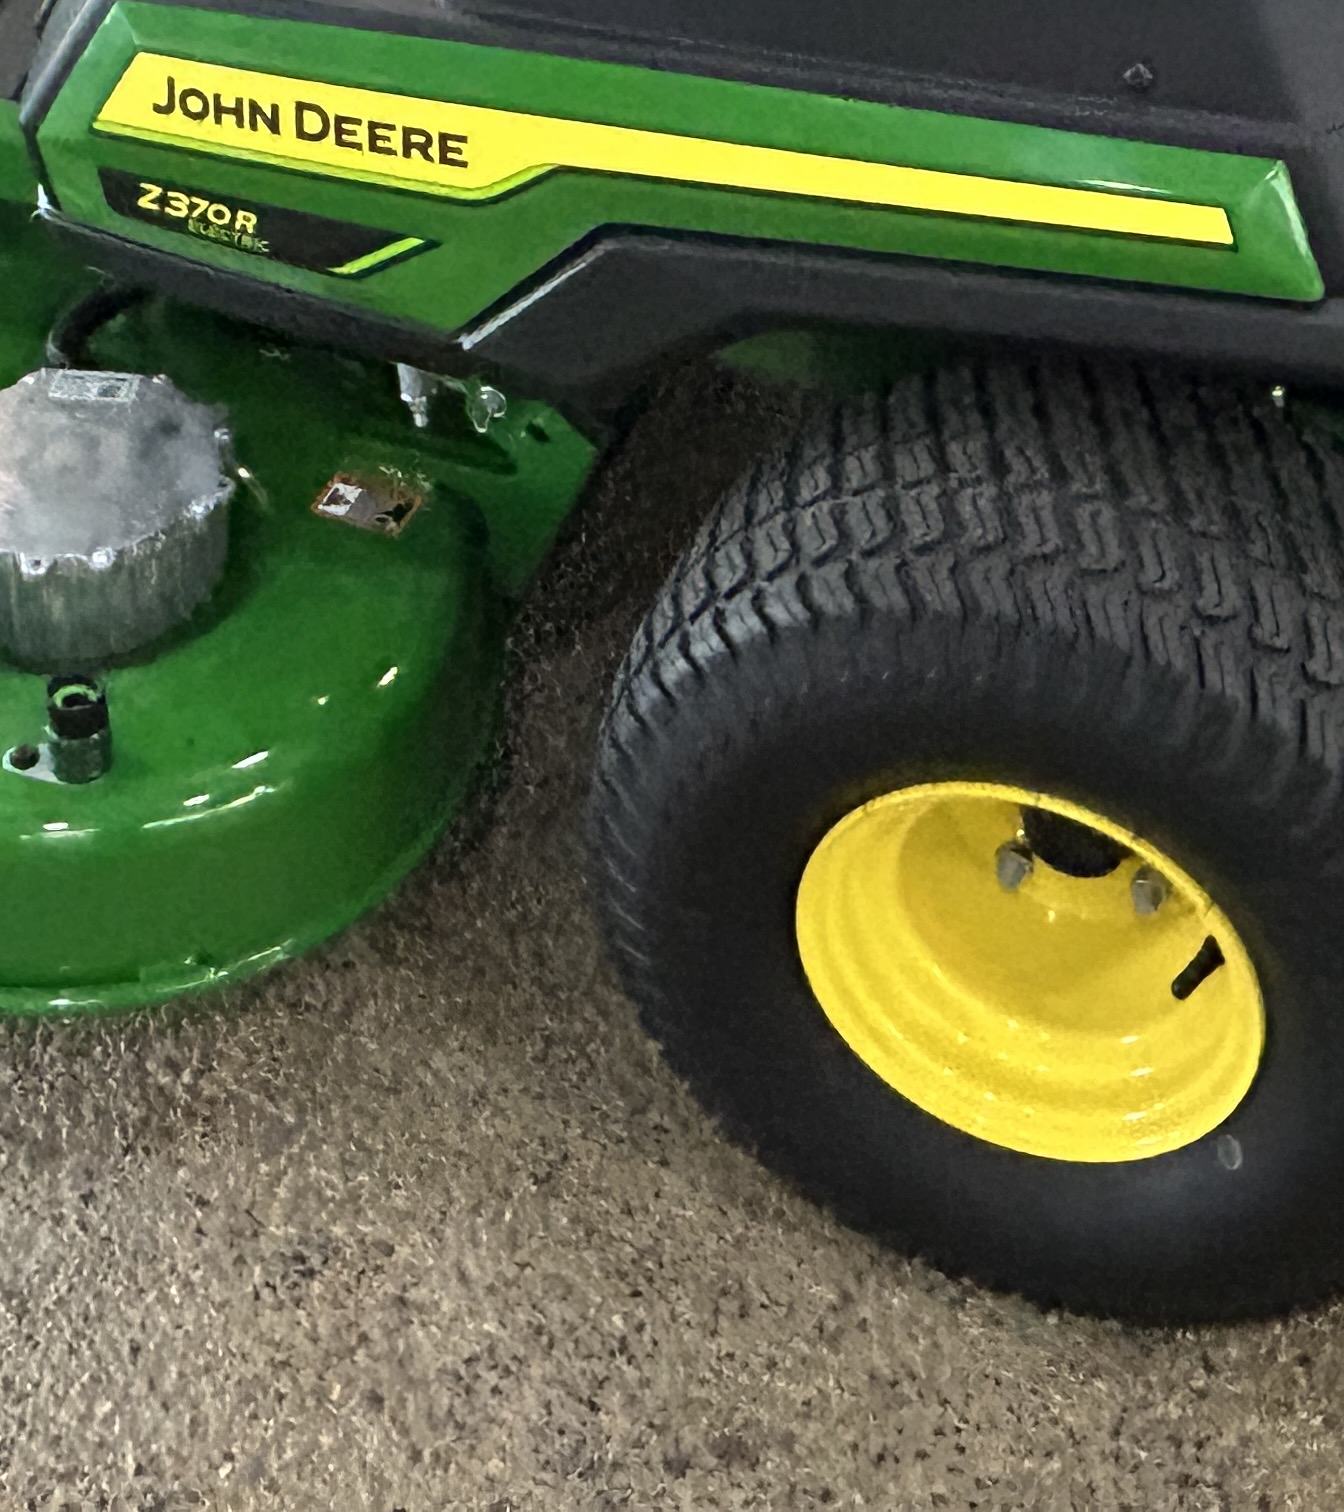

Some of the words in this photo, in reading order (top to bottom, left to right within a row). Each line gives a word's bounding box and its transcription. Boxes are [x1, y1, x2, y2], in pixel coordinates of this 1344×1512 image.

[152, 75, 281, 136] JOHN
[294, 100, 469, 169] DEERE
[137, 182, 257, 234] Z370R
